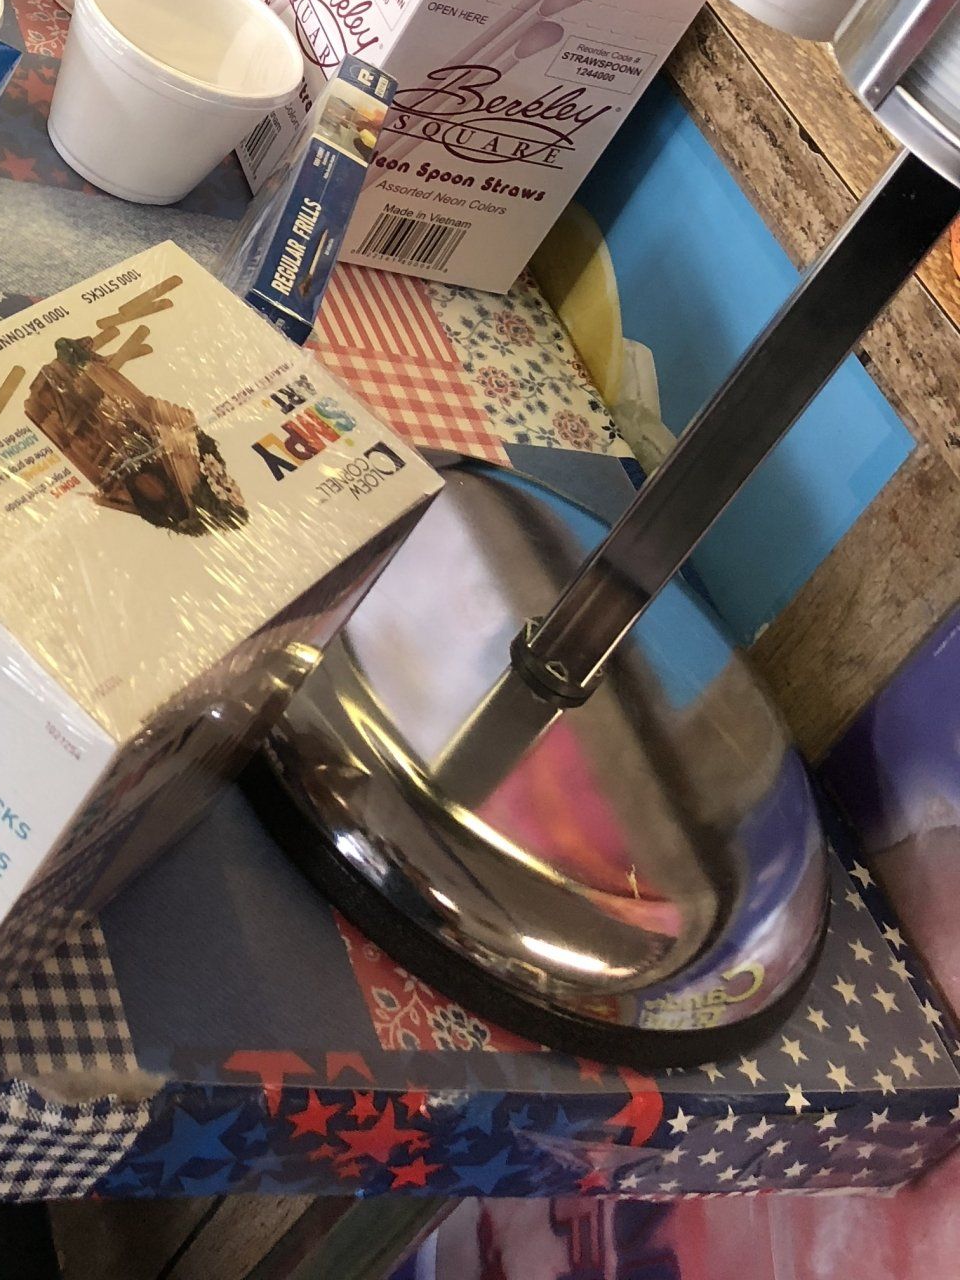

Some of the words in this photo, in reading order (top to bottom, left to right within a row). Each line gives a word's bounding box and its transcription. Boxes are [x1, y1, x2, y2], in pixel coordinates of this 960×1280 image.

[427, 1, 458, 18] OPEN
[458, 9, 489, 25] HERE
[561, 51, 644, 78] STRAWSPOONN
[576, 43, 611, 60] Reorder
[609, 50, 635, 64] Code
[633, 55, 642, 65] #
[575, 66, 616, 83] 1244000
[391, 64, 613, 128] Berkley
[392, 114, 562, 166] SQUARE
[416, 161, 476, 189] Spoon
[481, 176, 547, 203] Straws
[376, 179, 434, 202] Assorted
[432, 191, 468, 208] Neon
[468, 198, 507, 217] Colors
[383, 203, 415, 219] Made
[415, 208, 427, 220] in
[428, 211, 473, 230] Vietnam
[270, 238, 307, 297] REGULAR
[292, 197, 322, 241] FRILLS
[119, 268, 142, 287] 1000
[80, 278, 120, 305] STICKS
[43, 304, 71, 325] 1000
[317, 457, 370, 499] CORNELL
[349, 471, 387, 501] LOEW
